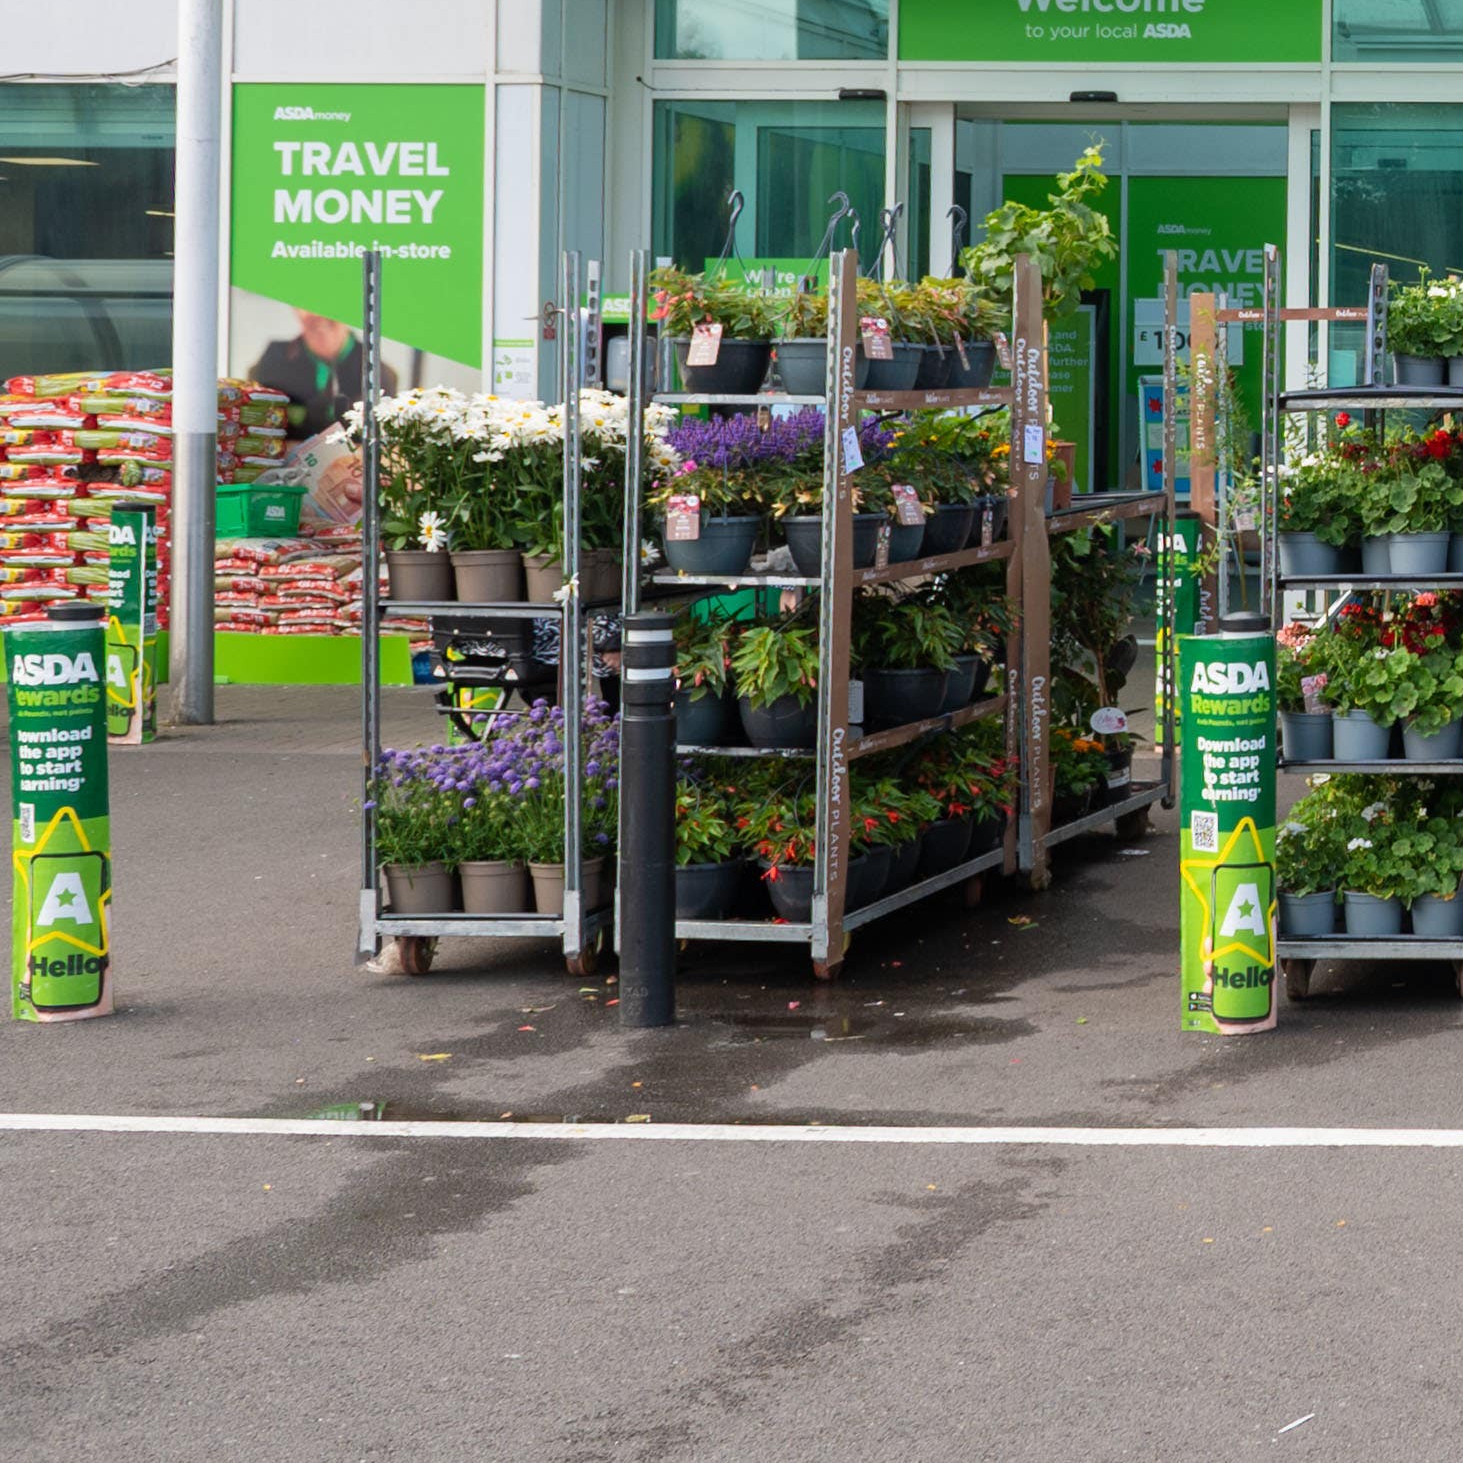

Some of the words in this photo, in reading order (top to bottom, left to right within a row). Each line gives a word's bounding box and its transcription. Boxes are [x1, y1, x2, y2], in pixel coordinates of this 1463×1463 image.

[1025, 23, 1044, 38] to
[1050, 26, 1090, 41] your
[1096, 23, 1137, 38] local
[1142, 23, 1192, 38] ASDA
[273, 141, 449, 176] TRAVEL
[274, 189, 444, 224] MONEY
[271, 240, 365, 258] Available
[841, 346, 854, 422] Outdoor
[1027, 348, 1043, 414] Outdoor
[13, 652, 99, 686] ASDA
[1191, 661, 1270, 694] ASDA
[16, 685, 99, 706] ewards
[1031, 676, 1047, 743] Outdoor
[1191, 694, 1270, 715] Rewards
[46, 745, 82, 761] app
[1197, 735, 1266, 752] Download
[36, 759, 82, 775] start
[831, 727, 849, 806] Outdoor
[1033, 746, 1042, 809] PLANTS
[1203, 753, 1226, 768] the
[1229, 754, 1259, 770] app
[1204, 769, 1218, 785] to
[1220, 769, 1260, 785] start
[829, 810, 841, 882] PLANTS
[37, 873, 93, 926] A
[1219, 883, 1265, 937] A
[30, 954, 101, 977] Hello
